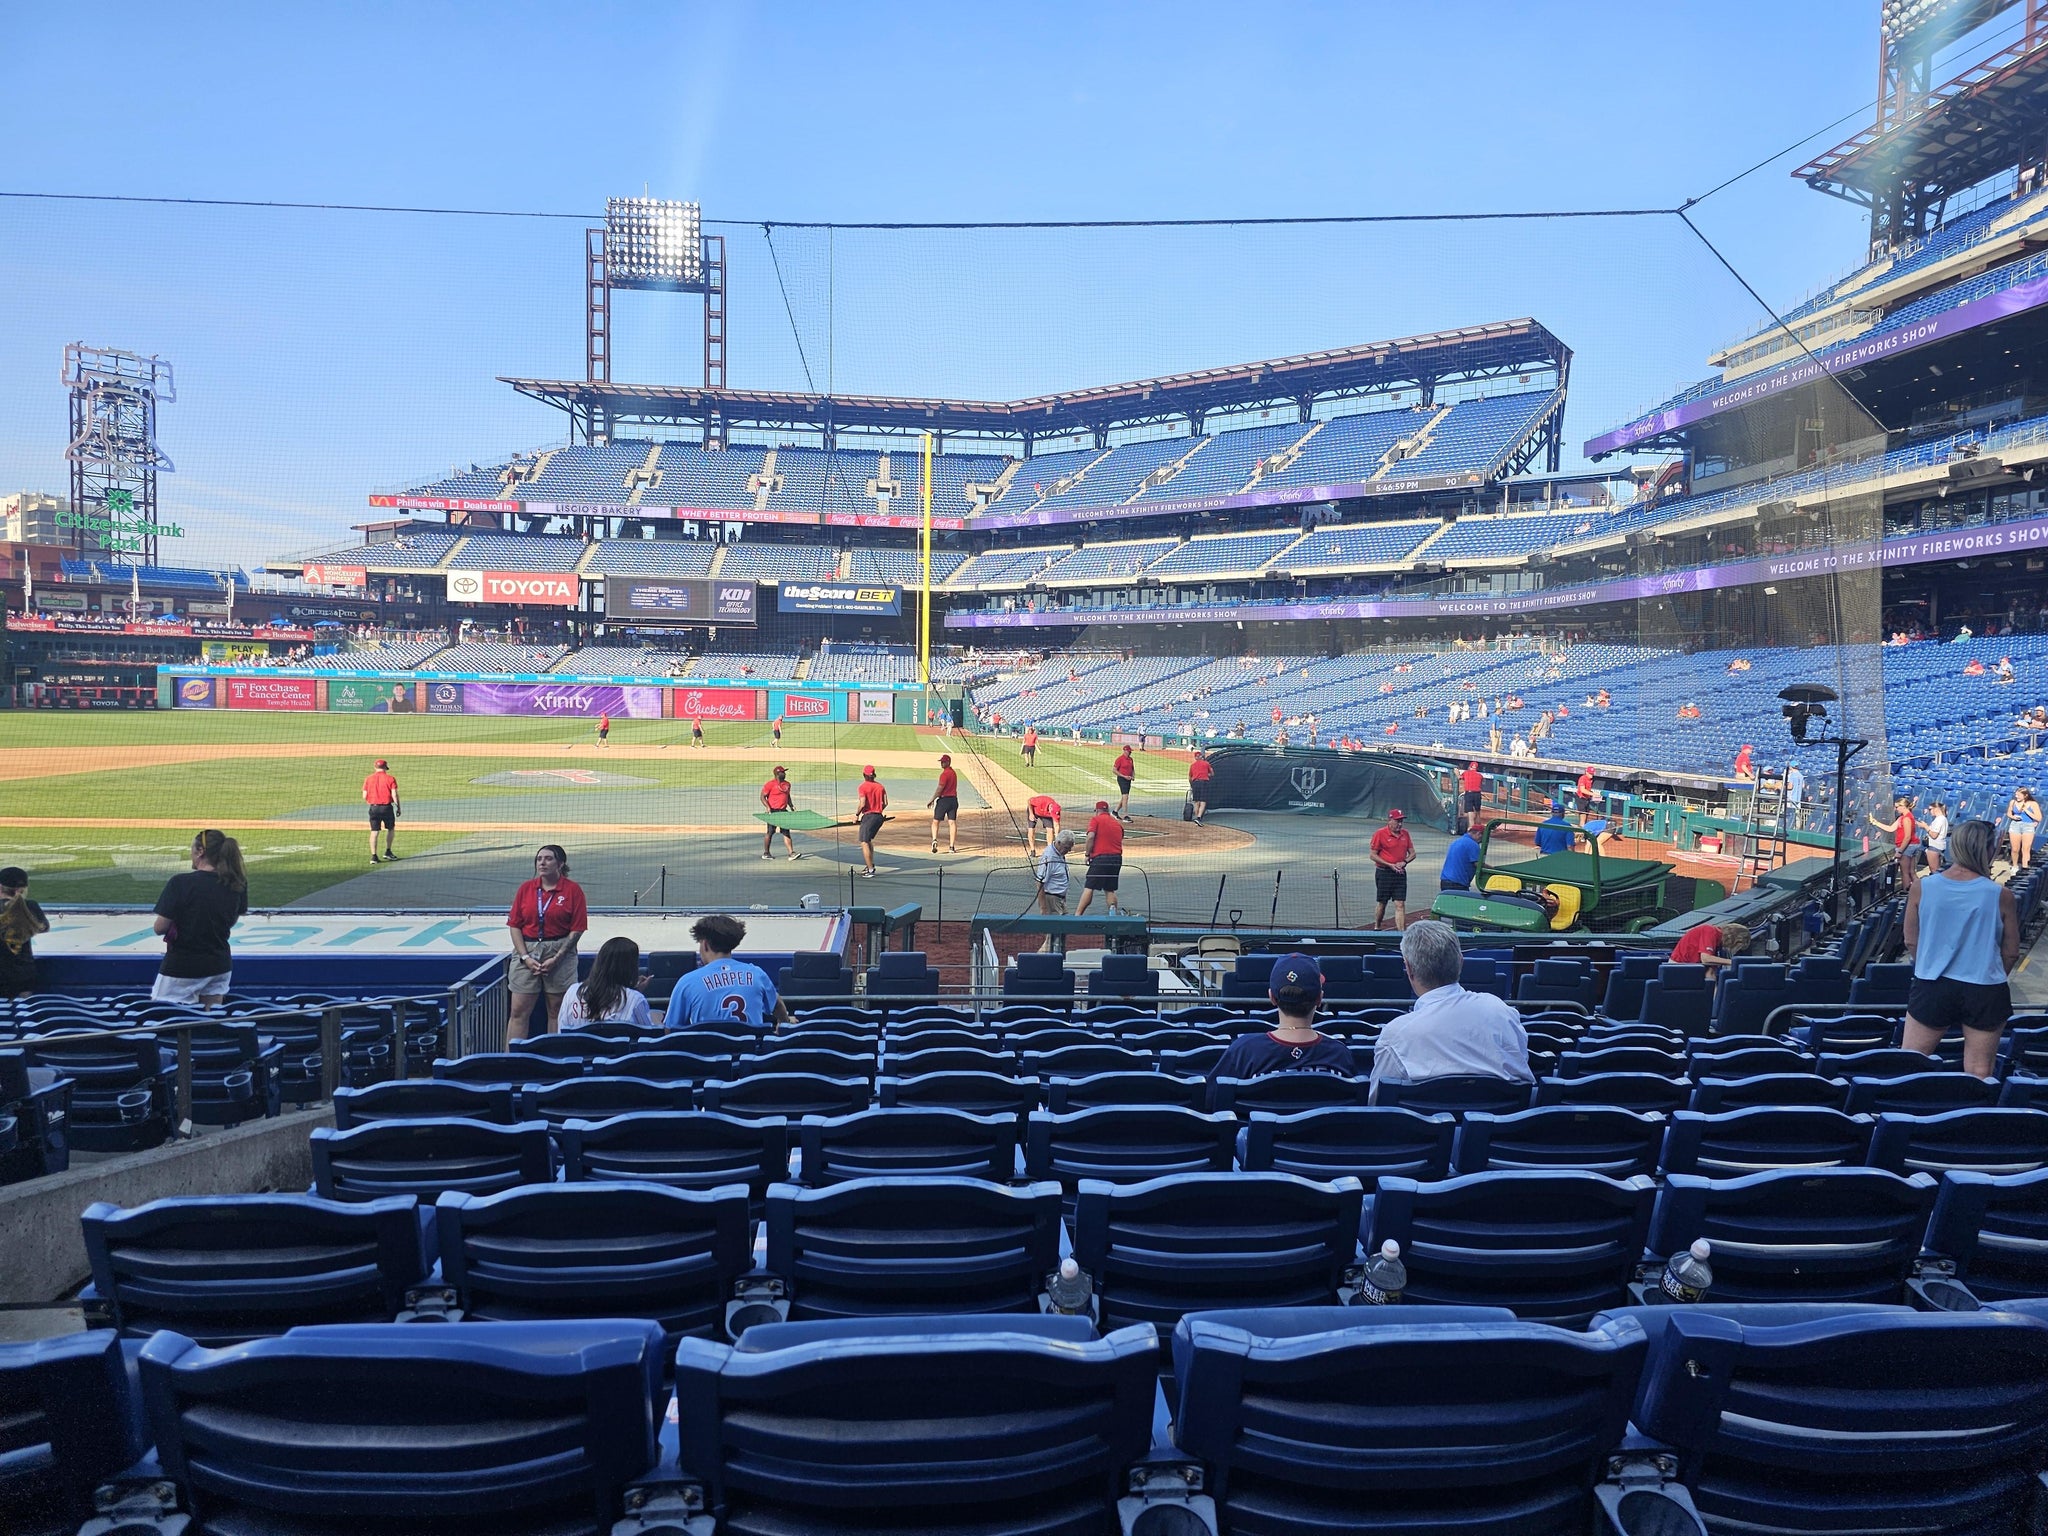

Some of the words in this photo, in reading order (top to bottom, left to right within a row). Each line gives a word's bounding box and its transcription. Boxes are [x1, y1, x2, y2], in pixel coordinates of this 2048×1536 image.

[1712, 386, 1753, 409] WELCOME
[1756, 382, 1768, 394] TO
[1771, 375, 1788, 389] THE
[1791, 358, 1832, 382] XFINITY
[1834, 336, 1898, 367] FIREWORKS
[1901, 321, 1939, 345] SHOW
[1375, 481, 1405, 492] 5:46:59
[1406, 480, 1419, 490] PM
[396, 499, 428, 508] Phillies
[428, 500, 445, 508] win
[463, 501, 488, 510] Deals
[488, 501, 503, 510] roll
[503, 502, 512, 511] in
[555, 504, 598, 514] LISCIO'S
[601, 506, 641, 515] BAKERY
[1072, 511, 1104, 519] WELCOME
[1105, 509, 1115, 517] TO
[1131, 505, 1159, 514] XFINITY
[1160, 501, 1202, 511] FIREWORKS
[1203, 499, 1226, 508] SHOW
[681, 510, 709, 518] WHEY
[709, 511, 741, 519] BETTER
[742, 512, 779, 520] PROTEIN
[54, 511, 133, 533] Citizens
[137, 519, 182, 538] Bank
[99, 534, 140, 551] Park
[1770, 558, 1820, 576] WELCOME
[1823, 556, 1838, 568] TO
[1842, 552, 1864, 566] THE
[1868, 544, 1917, 563] XFINITY
[1922, 532, 2003, 554] FIREWORKS
[487, 579, 571, 597] TOYOTA
[784, 586, 856, 600] theScore
[860, 590, 892, 600] BET
[1439, 603, 1489, 612] WELCOME
[1493, 602, 1507, 610] TO
[1509, 601, 1521, 610] THE
[1522, 598, 1544, 609] XFINITY
[1544, 593, 1577, 605] FIREWORKS
[1578, 590, 1597, 601] SHOW
[1073, 614, 1107, 622] WELCOME
[1108, 613, 1118, 621] TO
[1120, 613, 1134, 621] THE
[1136, 612, 1166, 620] XFINITY
[1167, 611, 1212, 620] FIREWORKS
[1213, 610, 1238, 618] SHOW
[146, 626, 185, 635] Budweiser
[272, 631, 308, 639] Budweiser
[231, 644, 254, 653] PLAY
[249, 683, 268, 692] Fox
[269, 683, 300, 693] Chase
[249, 690, 281, 699] Cancer
[281, 691, 312, 700] Center
[266, 699, 289, 707] Temple
[533, 691, 594, 711] xfinity
[684, 692, 746, 717] Chick-fil-A
[789, 699, 825, 713] HERR'S
[703, 971, 754, 992] HARPER
[721, 993, 749, 1024] 3
